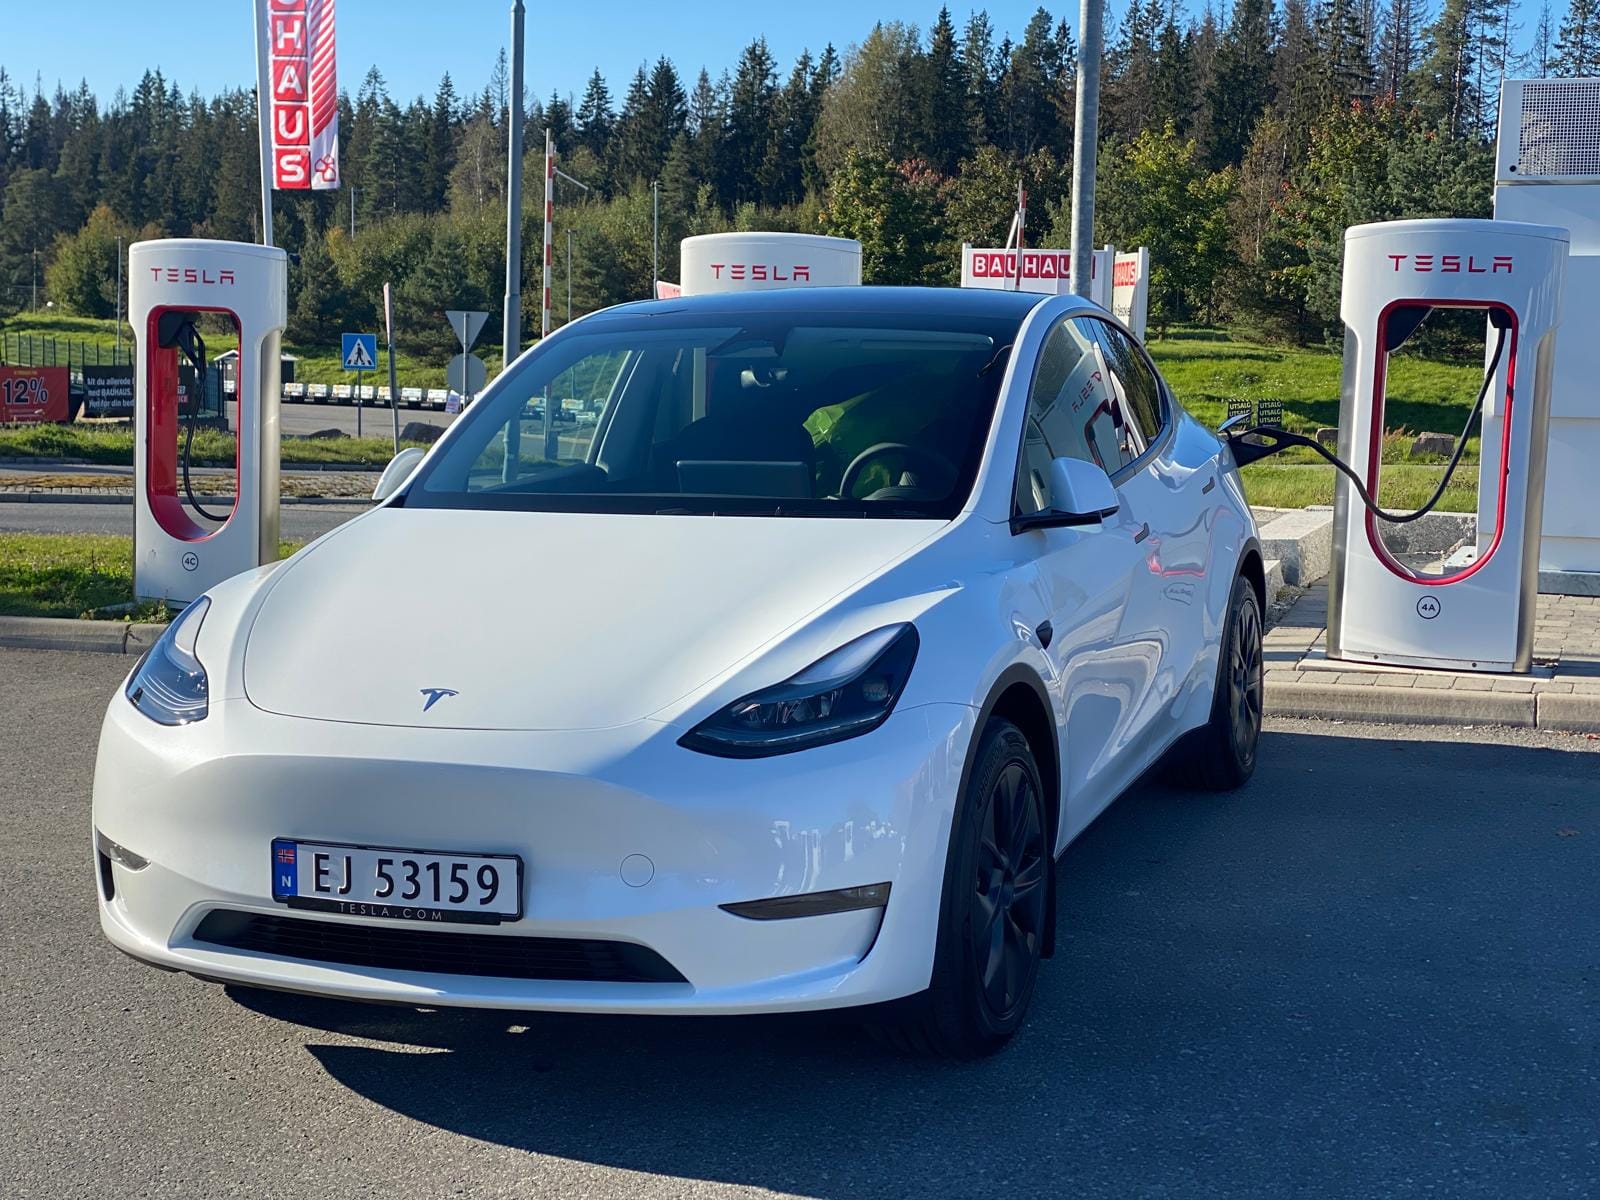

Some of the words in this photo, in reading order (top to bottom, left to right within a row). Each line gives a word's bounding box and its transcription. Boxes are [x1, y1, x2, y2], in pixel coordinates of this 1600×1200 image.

[276, 0, 306, 183] HAUS
[711, 264, 810, 281] TESLA
[973, 255, 1072, 276] BAUHAU
[1388, 254, 1513, 273] TESLA
[150, 267, 235, 285] TESLA
[2, 377, 49, 405] 12%
[184, 557, 196, 566] 4C
[1421, 603, 1436, 612] 4A
[281, 874, 292, 888] N
[313, 852, 352, 895] EJ
[374, 857, 500, 906] 53159
[339, 902, 443, 921] TESLA.COM
